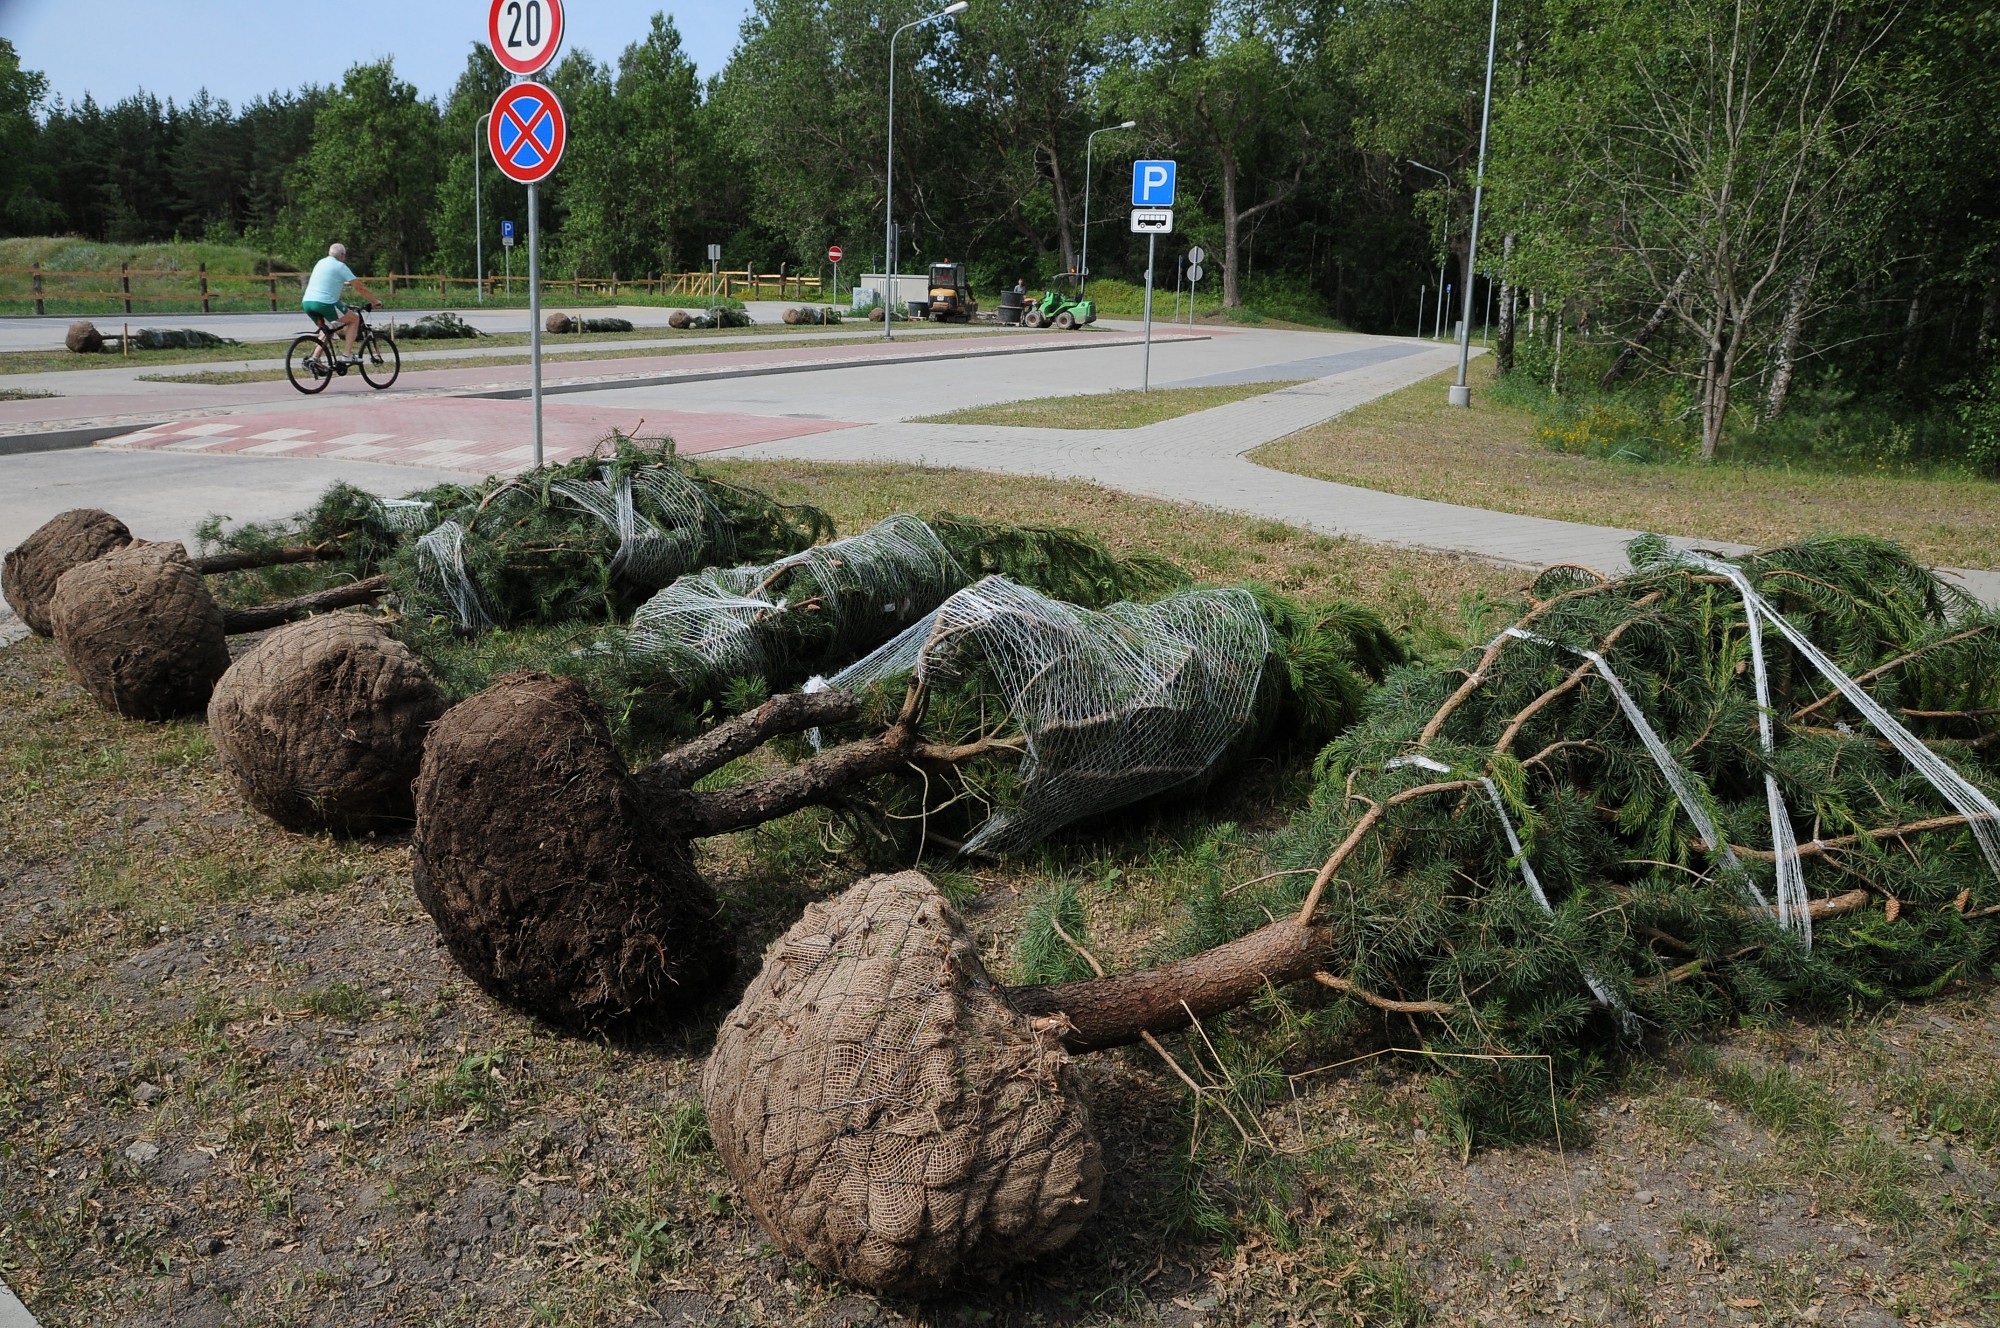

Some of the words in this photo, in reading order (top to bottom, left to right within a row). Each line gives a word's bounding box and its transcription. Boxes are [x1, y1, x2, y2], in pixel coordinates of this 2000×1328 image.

[507, 0, 541, 48] 20
[1143, 166, 1168, 201] P
[505, 223, 511, 235] P
